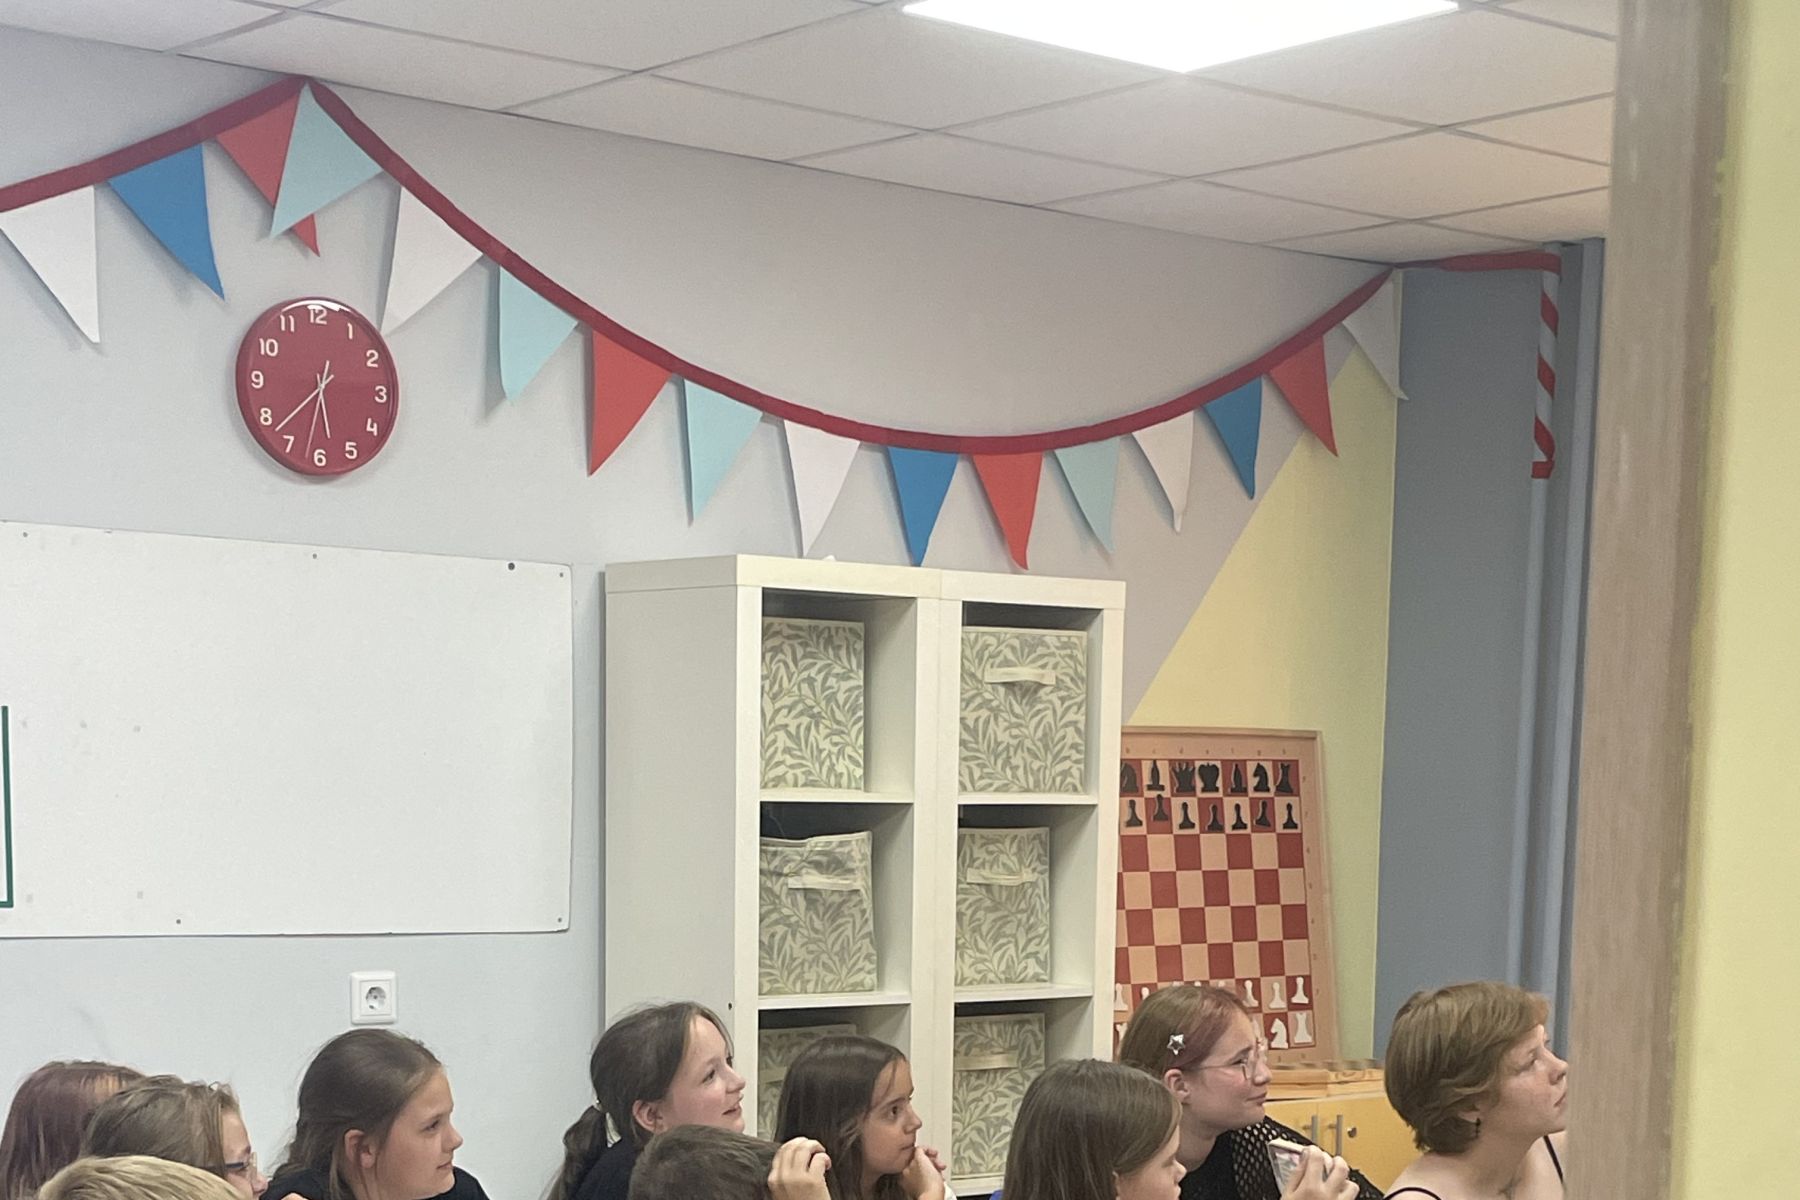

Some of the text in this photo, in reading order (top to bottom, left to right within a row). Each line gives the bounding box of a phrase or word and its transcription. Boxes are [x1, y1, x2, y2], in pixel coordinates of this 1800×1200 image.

[280, 315, 295, 332] 11
[309, 308, 328, 325] 12
[347, 323, 354, 340] 1
[259, 338, 279, 357] 10
[366, 350, 379, 368] 2
[251, 370, 264, 389] 9
[374, 385, 387, 403] 3
[259, 407, 272, 426] 8
[366, 418, 378, 437] 4
[283, 435, 295, 453] 7
[345, 441, 358, 460] 5
[313, 449, 327, 467] 6
